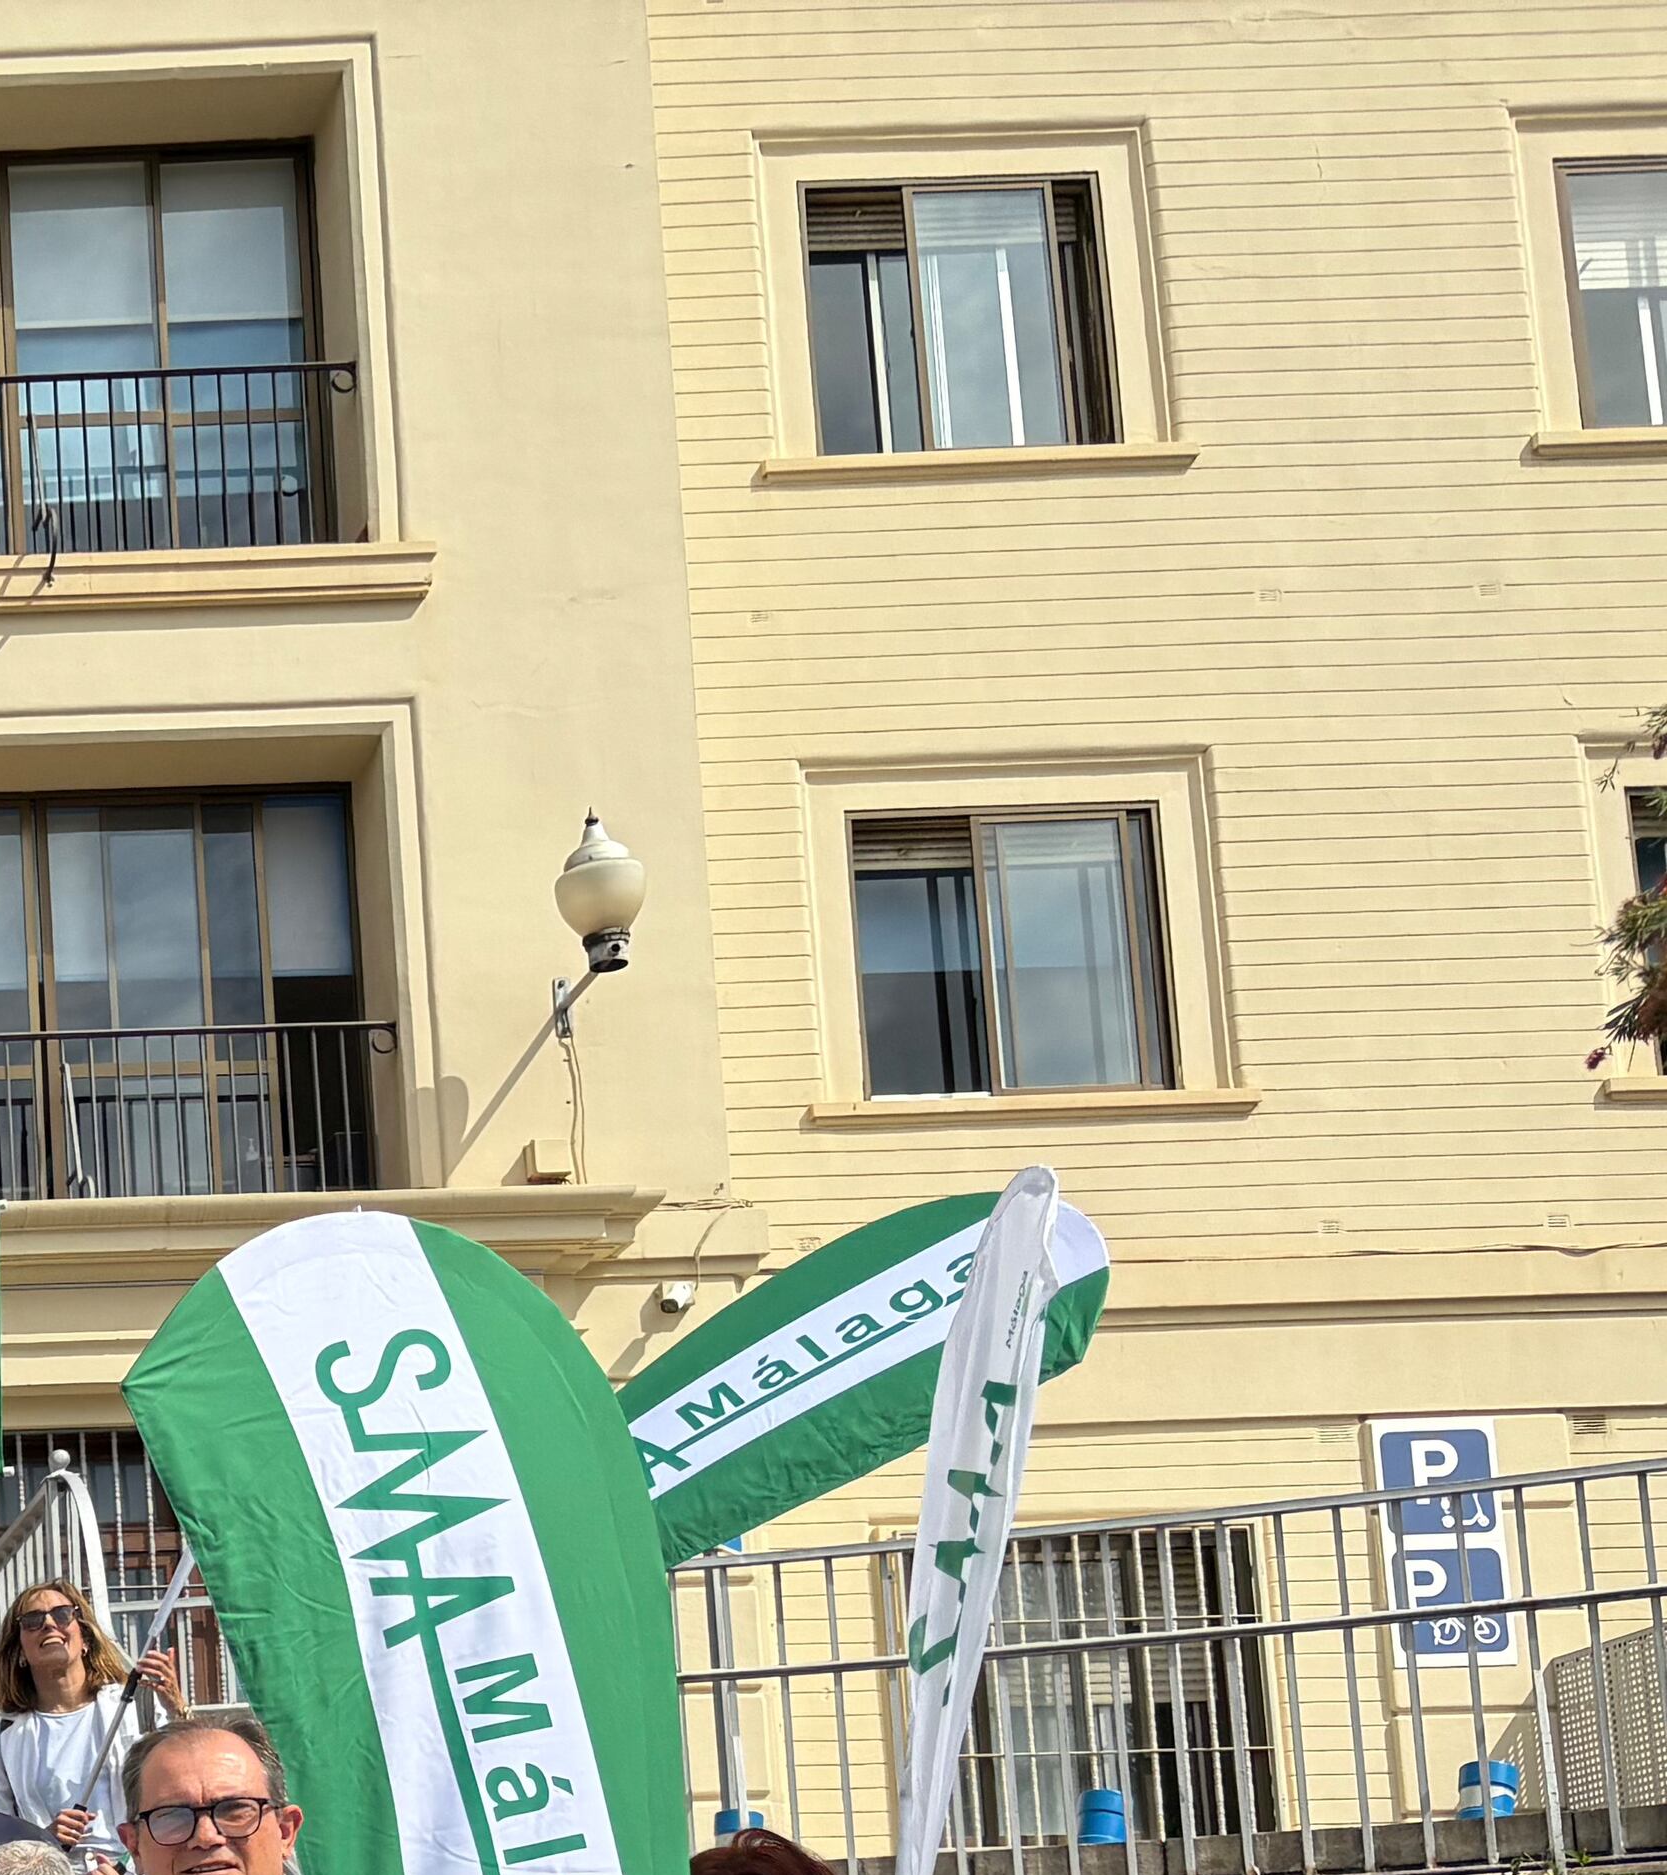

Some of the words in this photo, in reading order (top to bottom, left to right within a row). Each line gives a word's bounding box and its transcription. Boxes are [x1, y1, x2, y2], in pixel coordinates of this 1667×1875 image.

[314, 1328, 515, 1649] SMA
[1411, 1439, 1458, 1504] P
[1407, 1559, 1447, 1622] P
